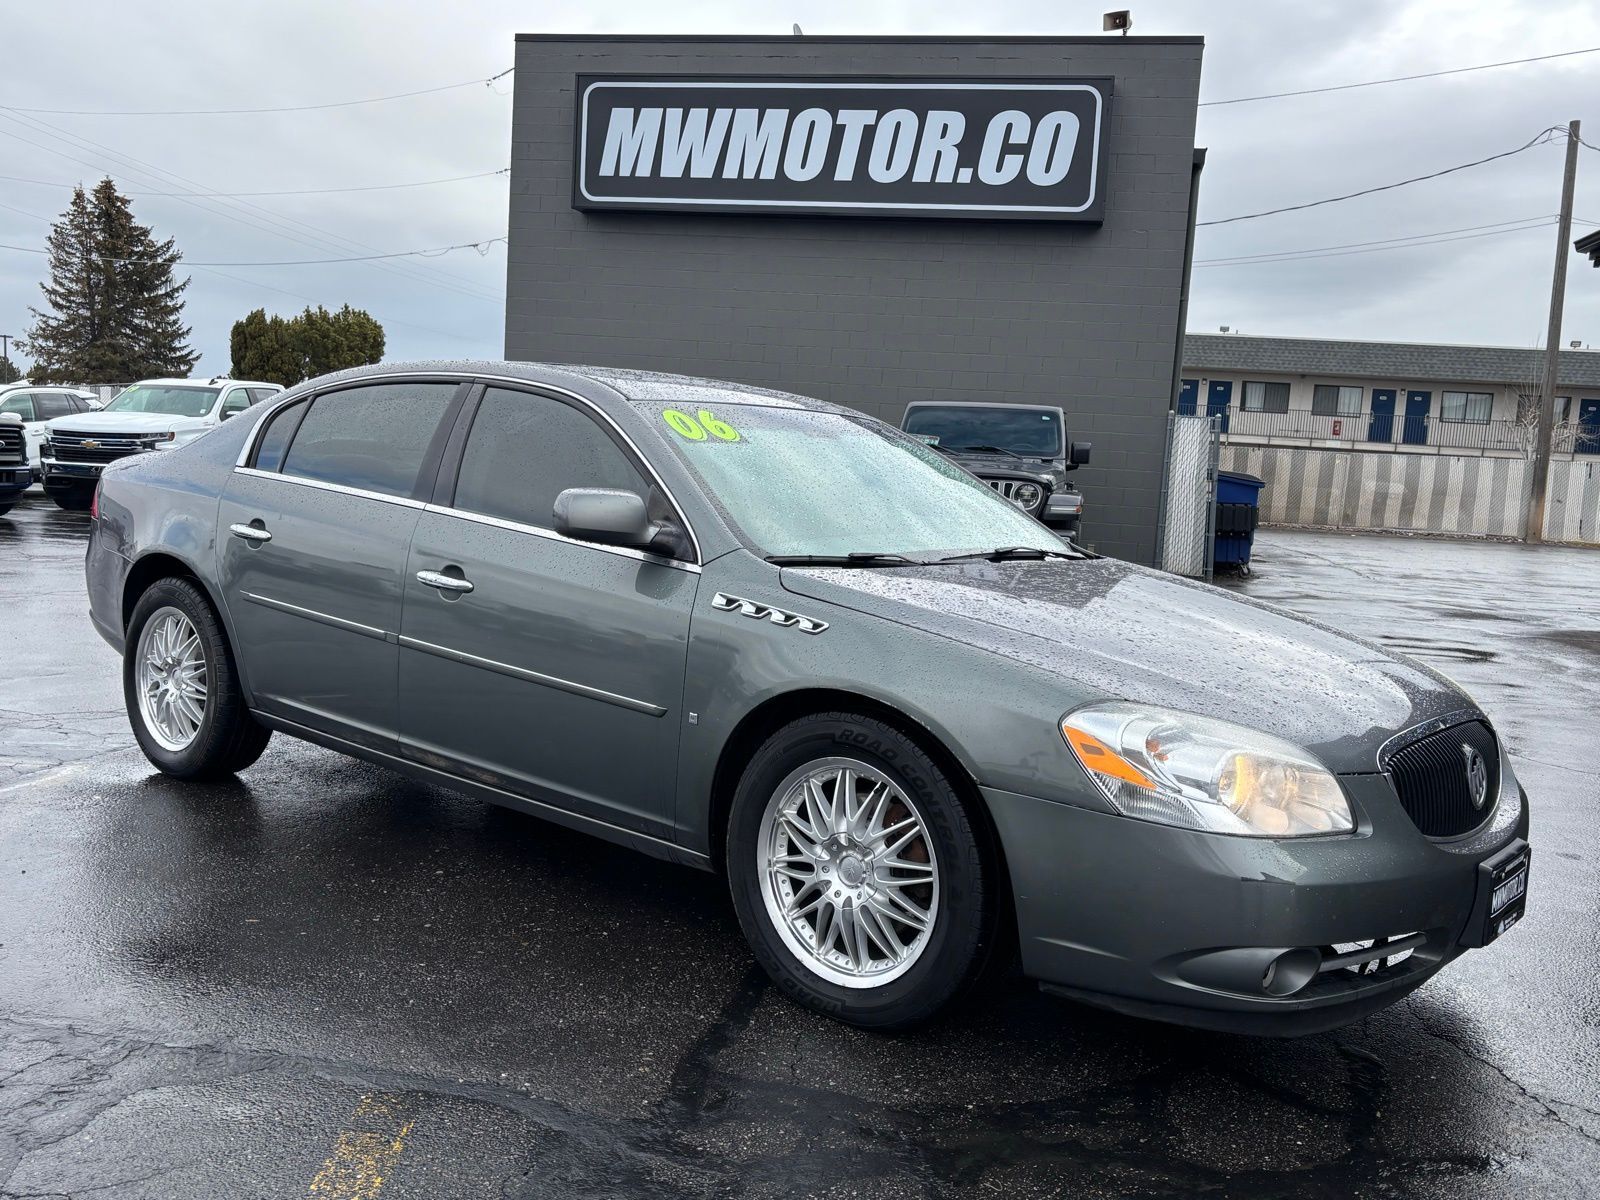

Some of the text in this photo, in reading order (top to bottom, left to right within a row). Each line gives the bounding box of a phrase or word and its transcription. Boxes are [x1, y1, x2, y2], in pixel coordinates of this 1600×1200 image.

[599, 107, 1080, 187] MWMOTOR.CO
[662, 409, 742, 441] 06
[838, 728, 898, 760] ROAD
